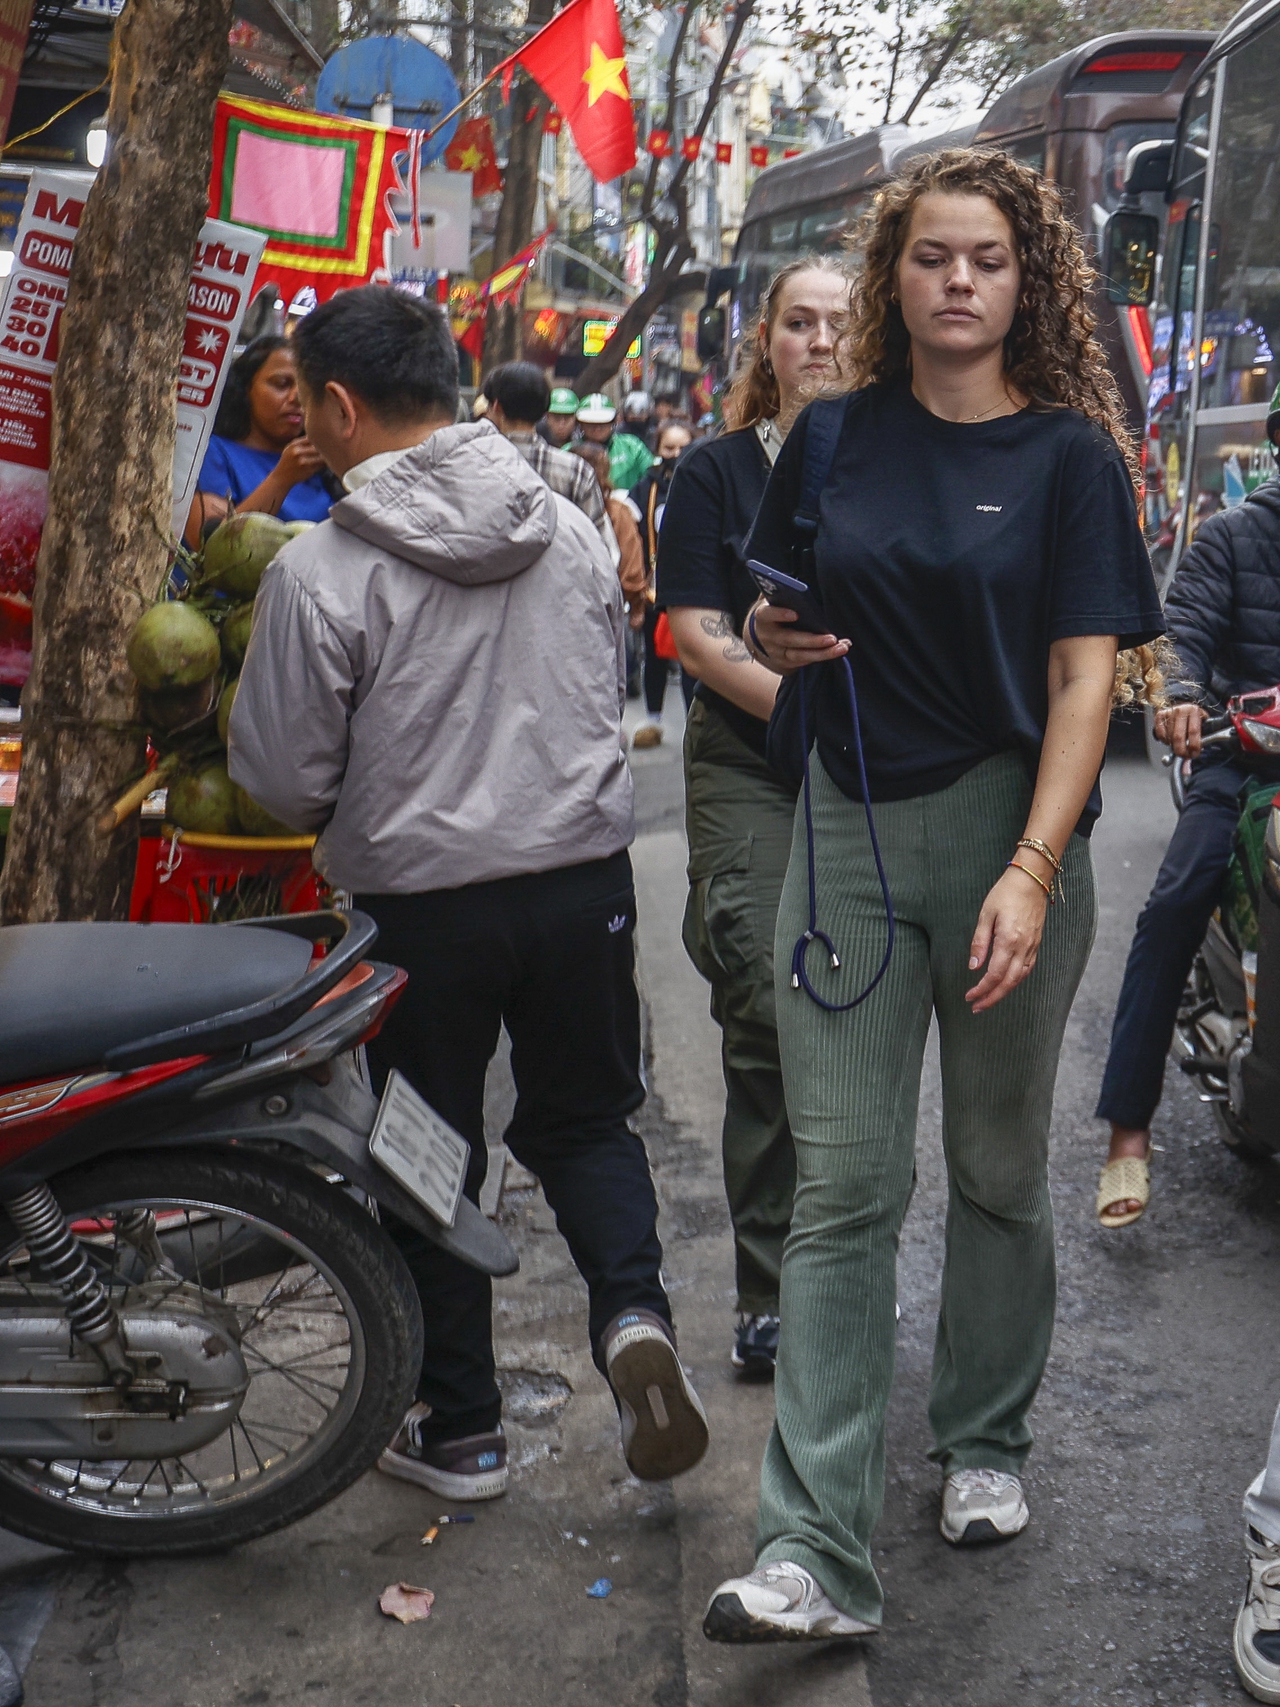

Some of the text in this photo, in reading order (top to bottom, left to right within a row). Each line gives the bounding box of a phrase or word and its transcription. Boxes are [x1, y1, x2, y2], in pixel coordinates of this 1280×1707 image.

[33, 190, 85, 227] M
[26, 236, 233, 315] POM ASON
[17, 277, 67, 303] ONL
[10, 295, 51, 319] 25
[6, 315, 48, 338] 30
[0, 333, 41, 356] 40
